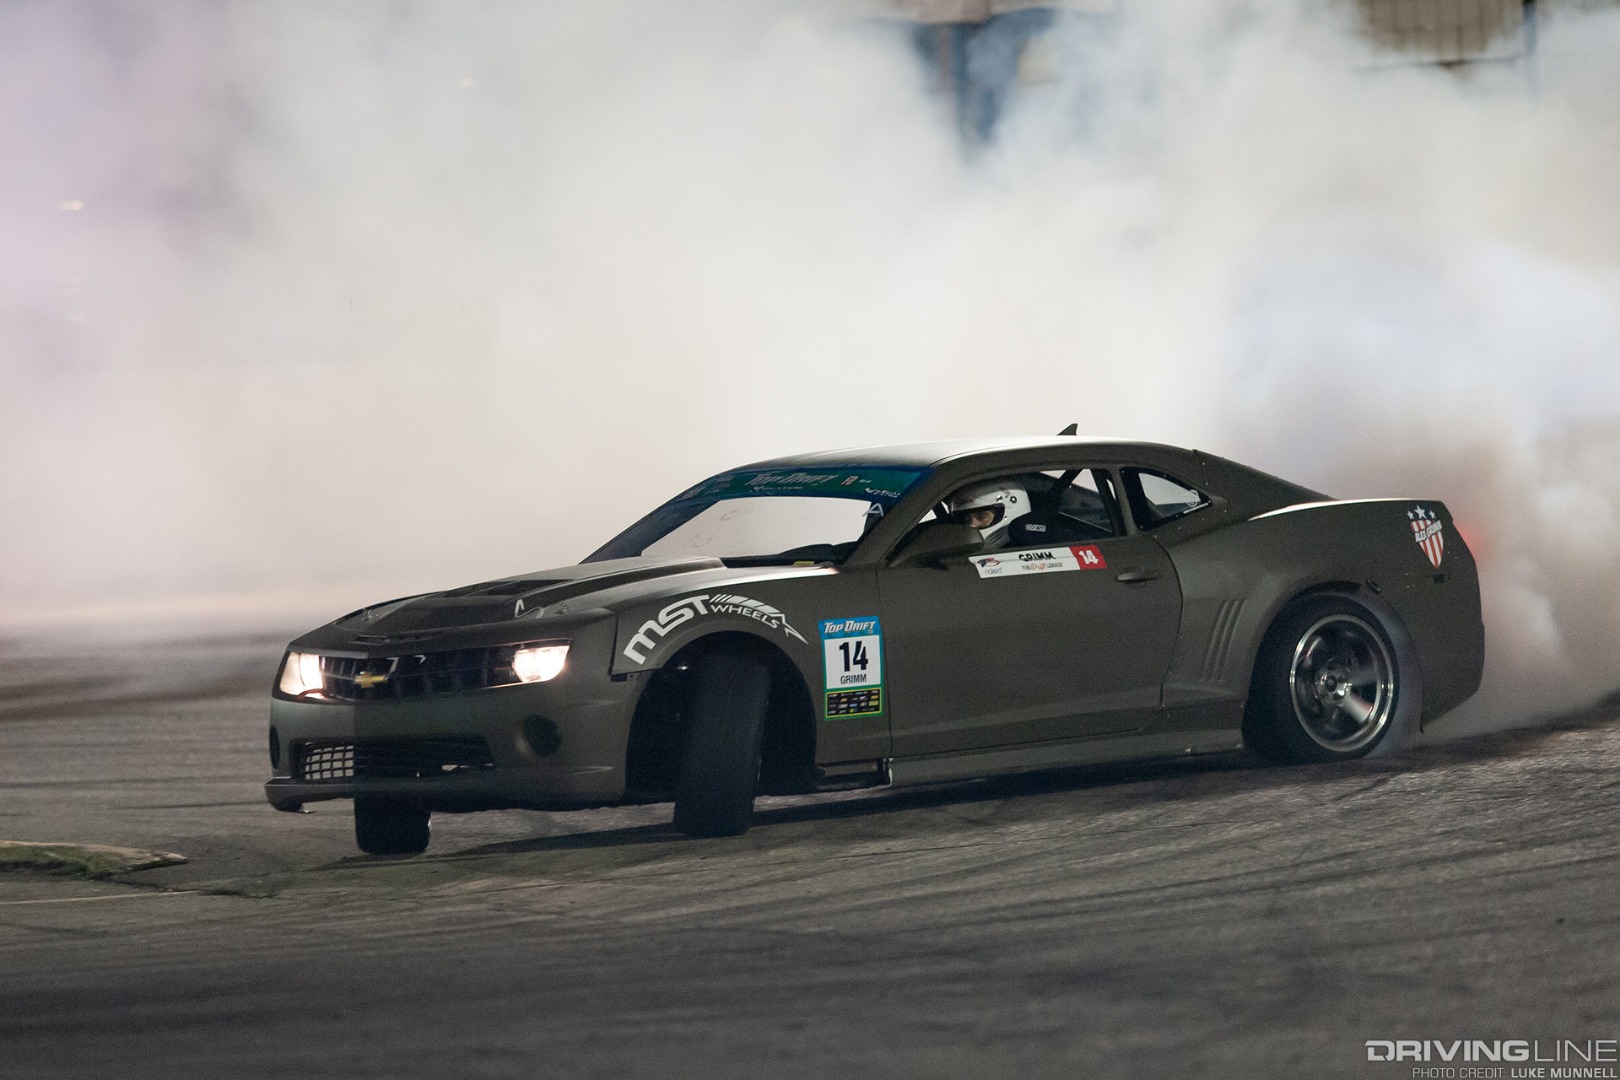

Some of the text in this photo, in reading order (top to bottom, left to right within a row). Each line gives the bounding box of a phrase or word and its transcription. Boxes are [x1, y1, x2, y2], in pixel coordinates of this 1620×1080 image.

[1018, 551, 1056, 562] GRIMM
[1078, 549, 1099, 565] 14
[710, 604, 780, 629] WHEELS
[623, 595, 710, 665] MST
[824, 620, 876, 634] TOP DRIFT
[839, 640, 869, 672] 14
[840, 674, 867, 685] GRIMM
